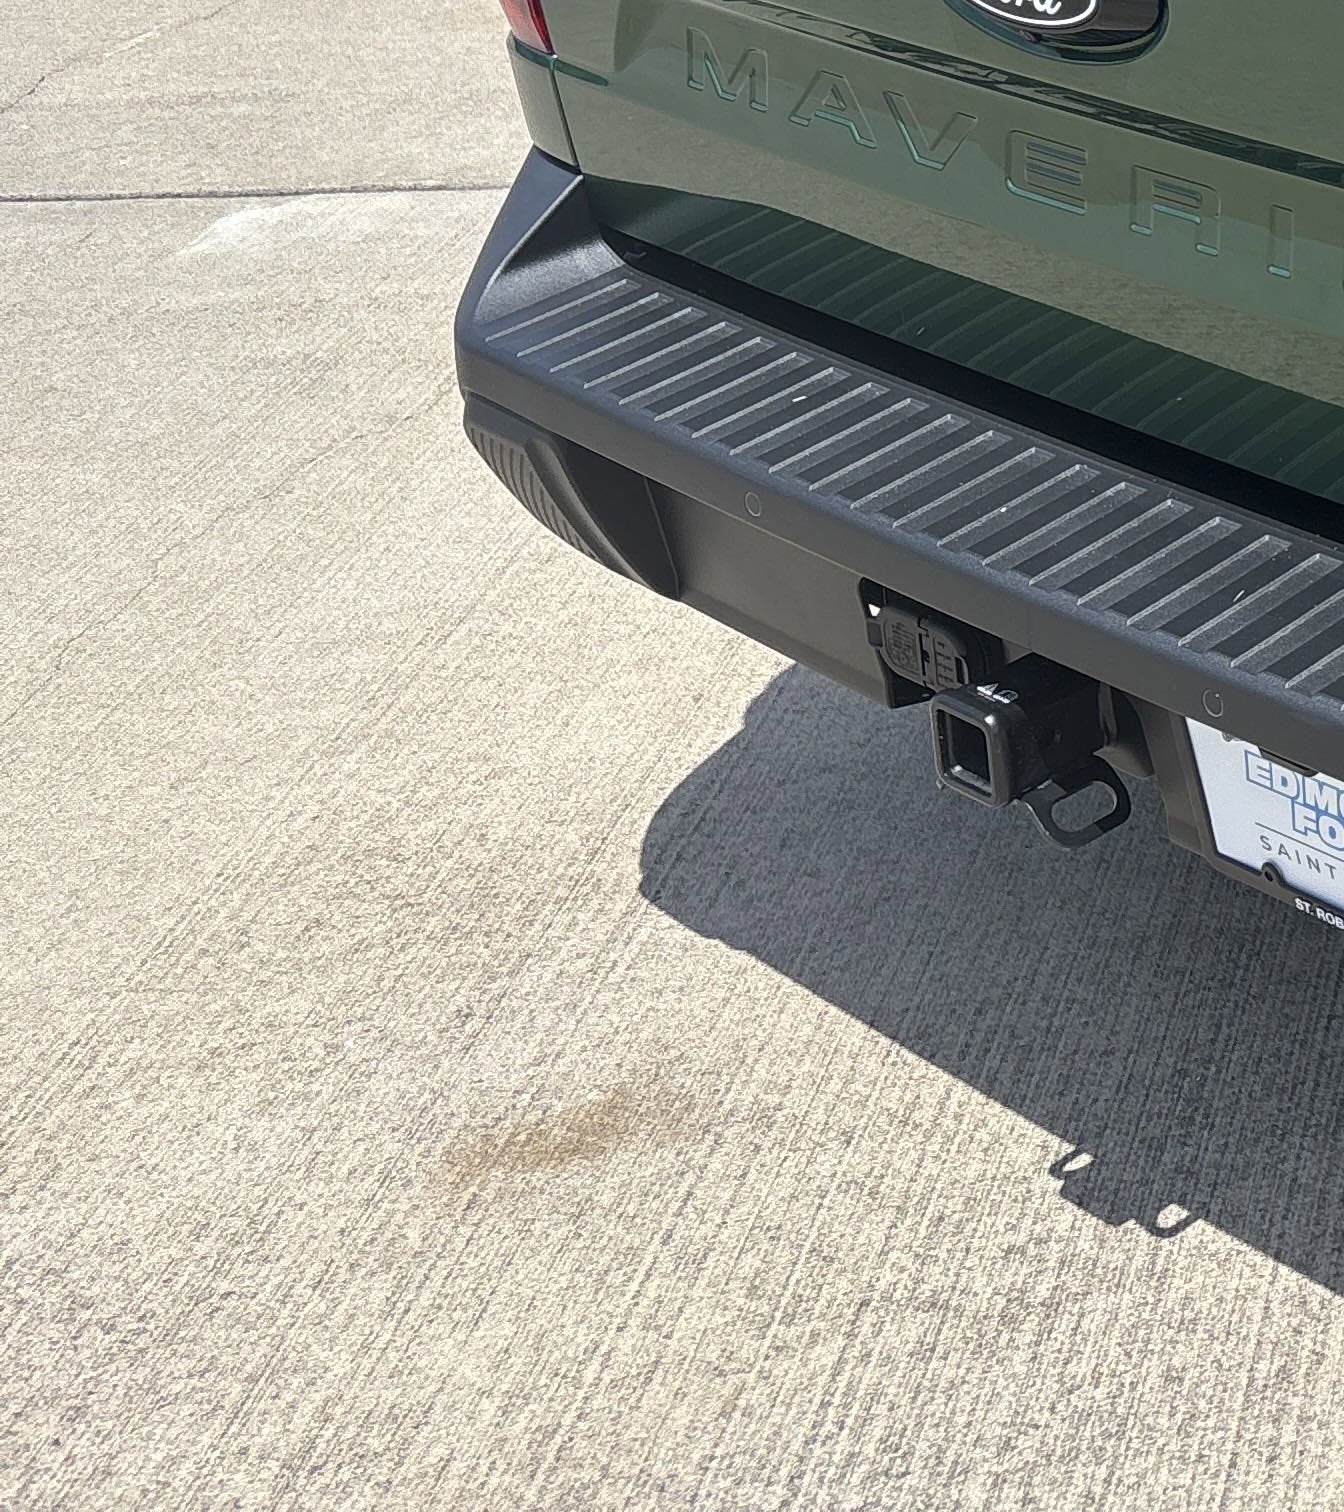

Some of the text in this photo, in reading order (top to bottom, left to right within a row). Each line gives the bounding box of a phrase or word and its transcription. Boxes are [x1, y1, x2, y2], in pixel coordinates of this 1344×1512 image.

[1244, 749, 1300, 800] ED
[1259, 834, 1337, 881] SAINT
[1294, 896, 1315, 917] ST.
